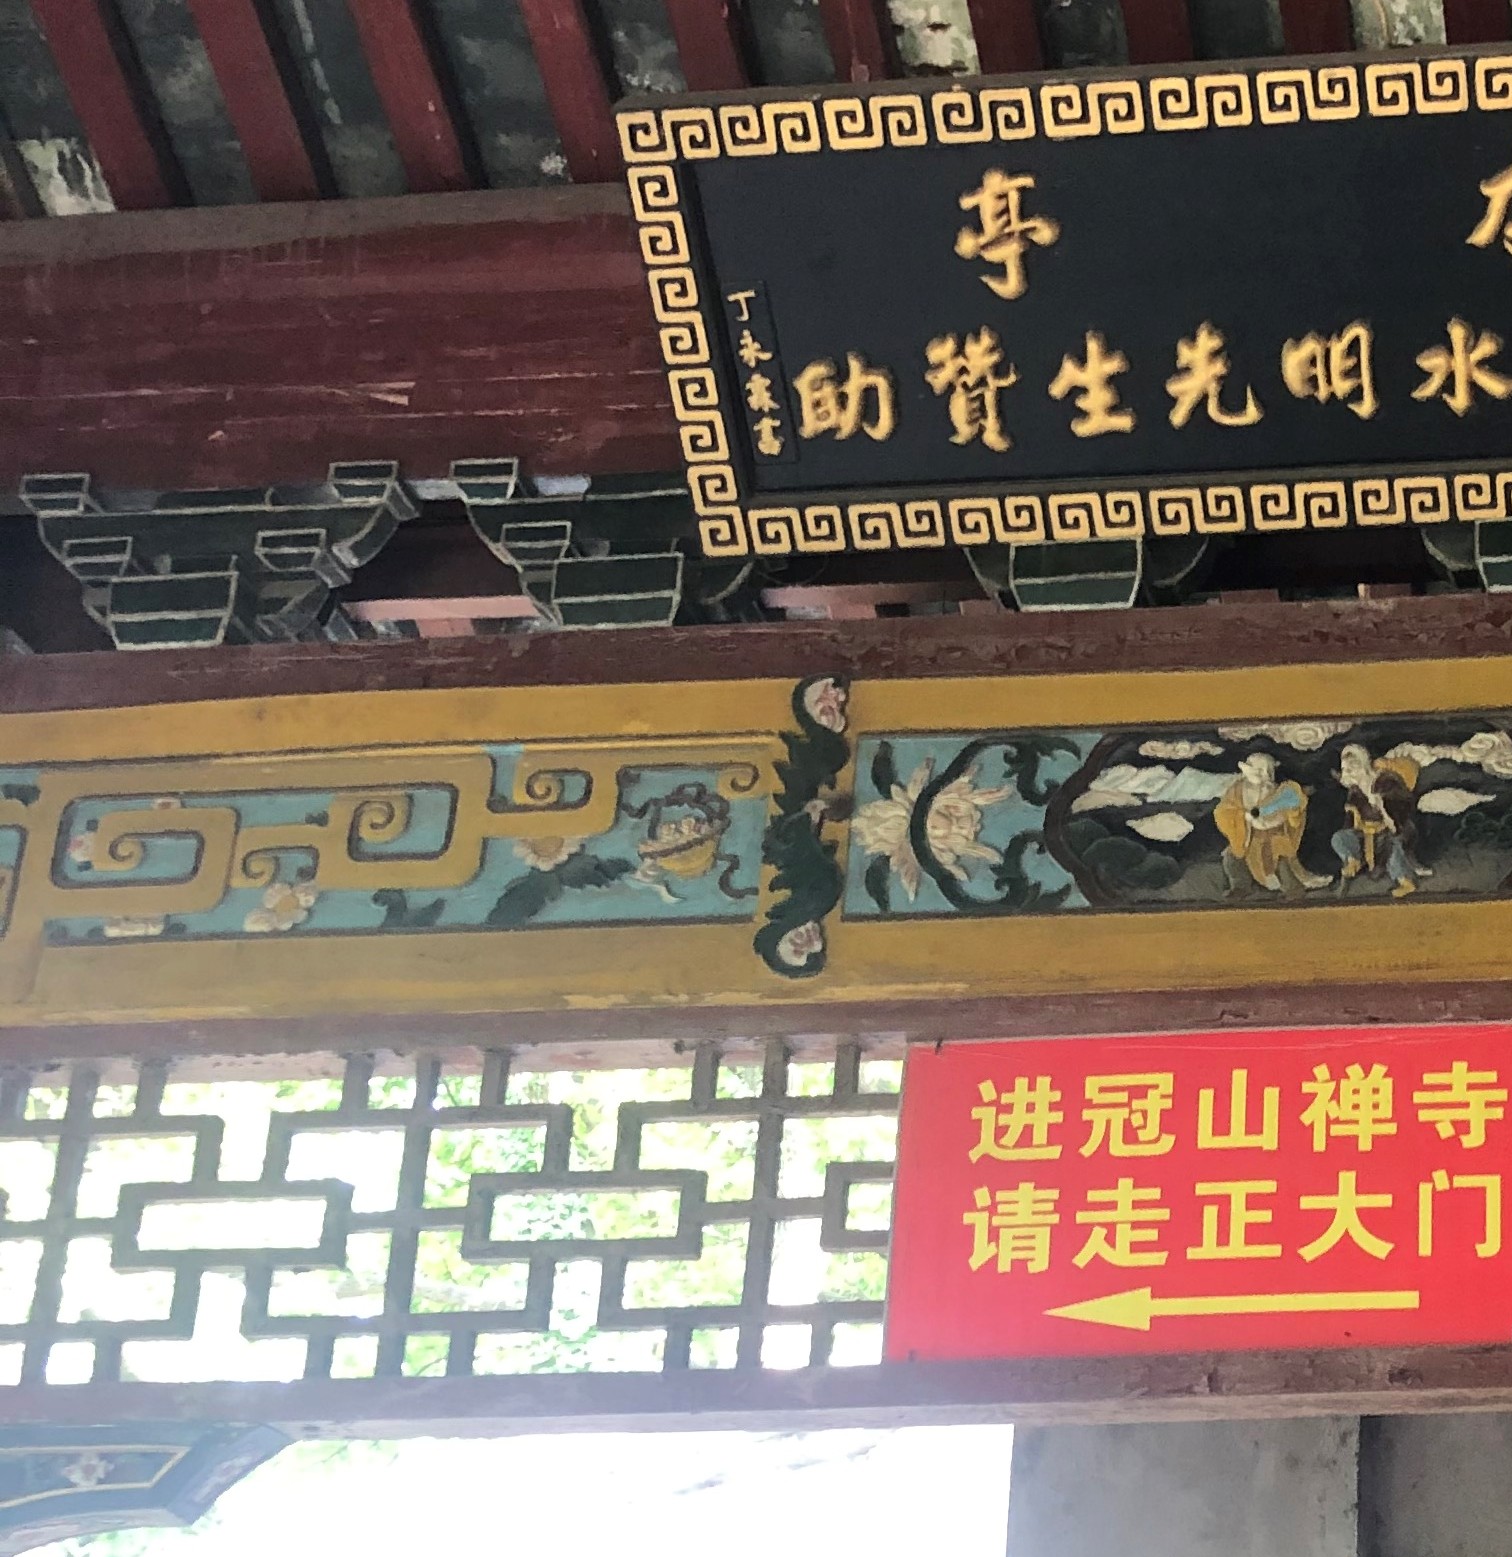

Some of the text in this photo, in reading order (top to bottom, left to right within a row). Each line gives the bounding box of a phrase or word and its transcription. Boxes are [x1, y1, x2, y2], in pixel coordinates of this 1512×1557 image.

[968, 1061, 1508, 1163] 进冠山禅寺
[963, 1170, 1502, 1273] 请走正大门
